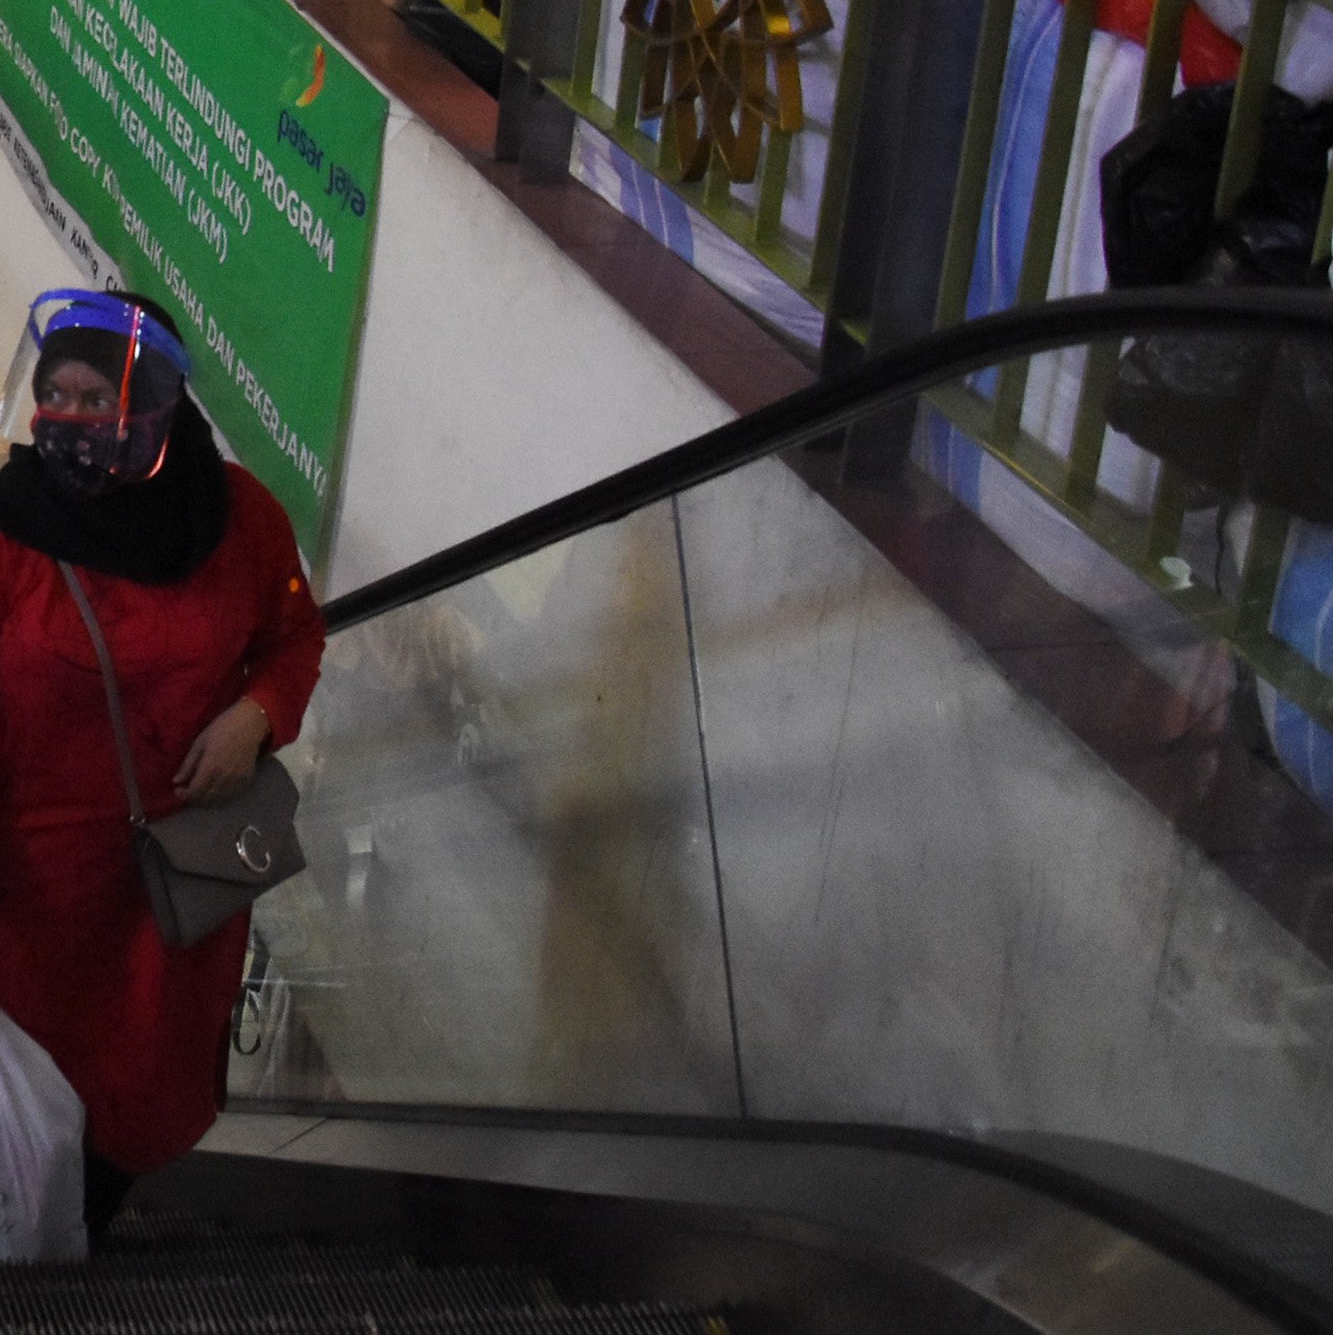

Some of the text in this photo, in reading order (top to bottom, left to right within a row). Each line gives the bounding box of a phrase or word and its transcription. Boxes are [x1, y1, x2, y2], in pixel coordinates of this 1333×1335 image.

[49, 4, 73, 55] DAN
[120, 99, 188, 207] KEMATIAN
[187, 189, 228, 266] (JKM)
[159, 36, 251, 172] TERLINDUNGI
[252, 148, 335, 274] PROGRAM
[165, 101, 209, 180] KERJA
[211, 160, 251, 236] (JKK)
[277, 109, 323, 173] pasar
[163, 254, 204, 333] USAHA
[205, 315, 236, 377] DAN
